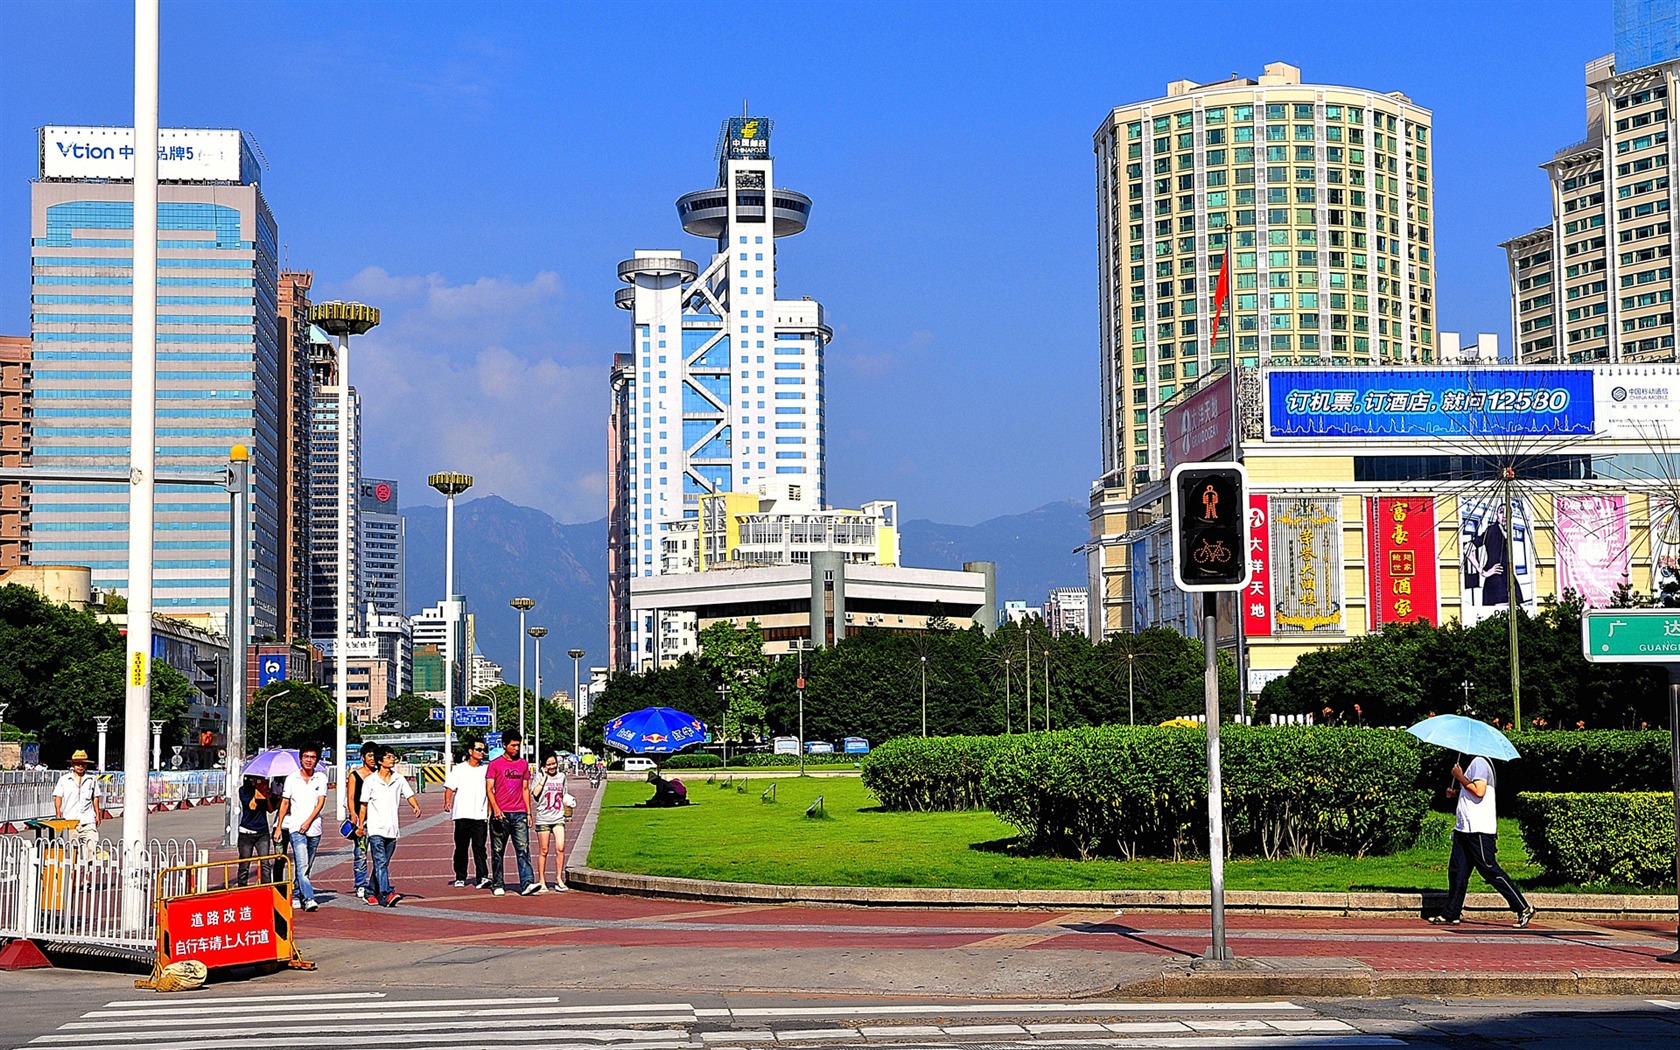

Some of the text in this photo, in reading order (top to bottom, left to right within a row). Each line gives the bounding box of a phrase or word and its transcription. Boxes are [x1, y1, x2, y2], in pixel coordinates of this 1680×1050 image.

[56, 141, 115, 160] Vtion
[190, 906, 252, 928] 道路改造
[175, 928, 270, 956] 自行车请上人行道
